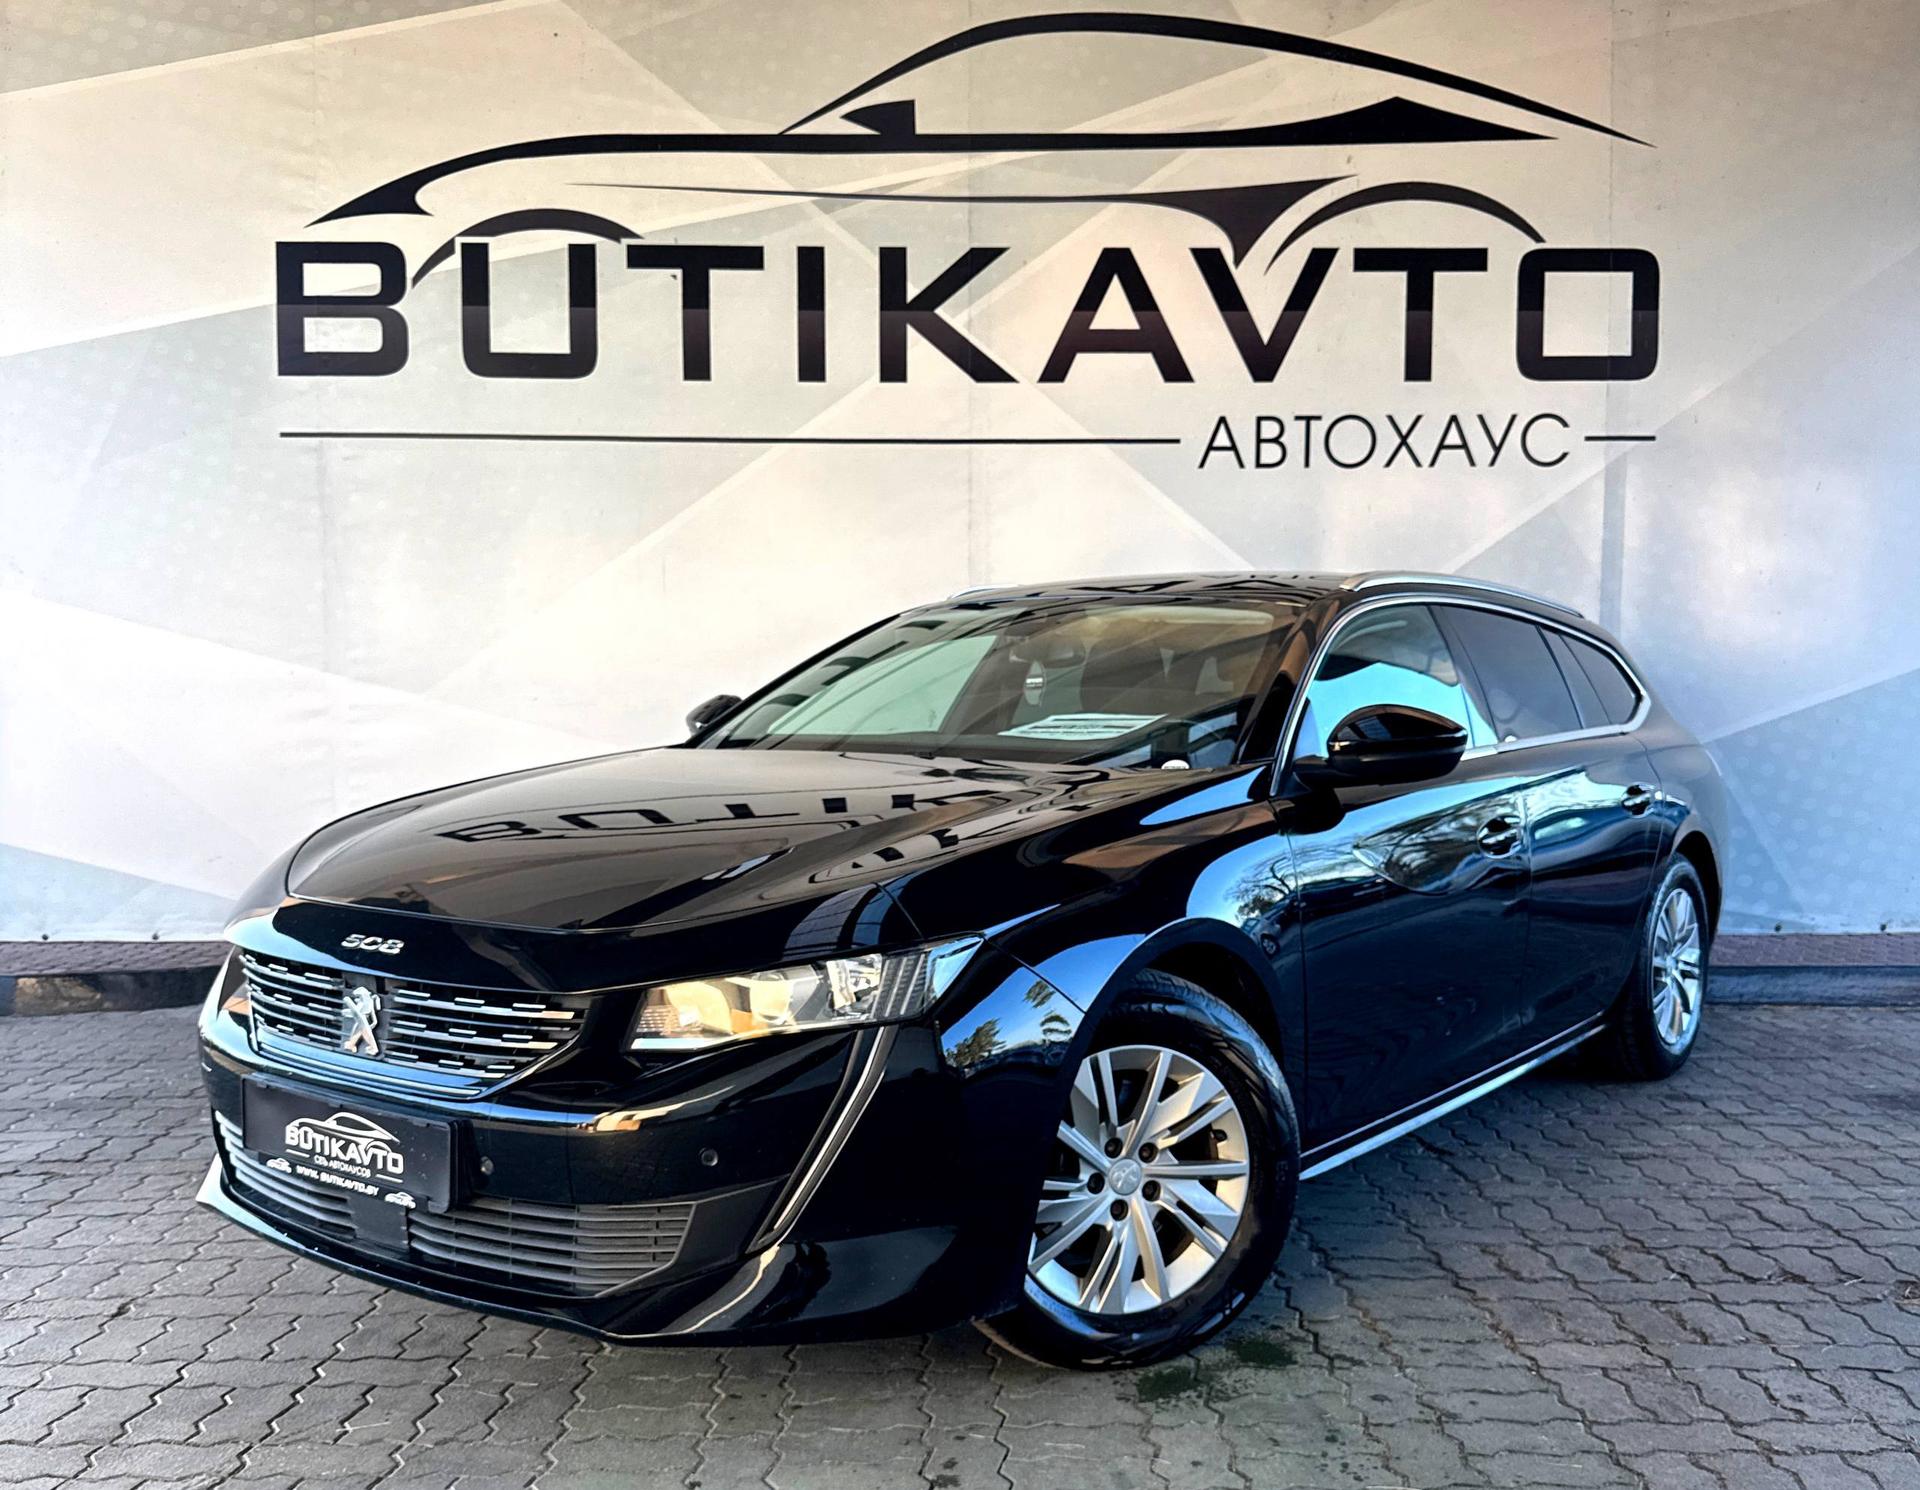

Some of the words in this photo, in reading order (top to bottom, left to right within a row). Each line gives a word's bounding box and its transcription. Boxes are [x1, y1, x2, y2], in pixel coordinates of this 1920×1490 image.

[276, 242, 1660, 382] BUTIKAVTO
[1199, 413, 1569, 469] АВТОХАУС
[342, 934, 404, 955] 508
[285, 1126, 403, 1174] BUTIKAVTO
